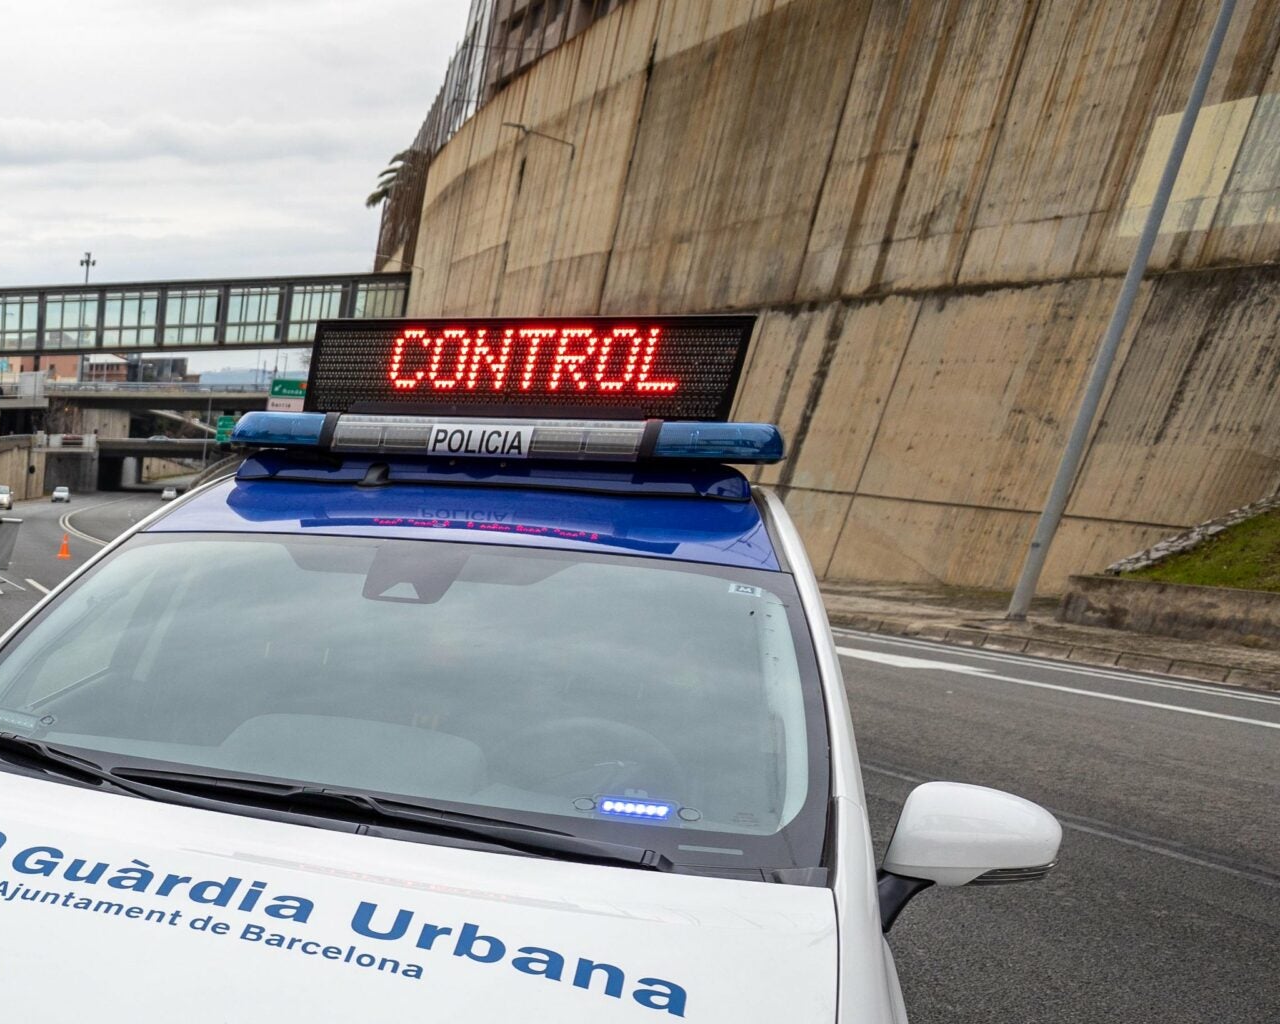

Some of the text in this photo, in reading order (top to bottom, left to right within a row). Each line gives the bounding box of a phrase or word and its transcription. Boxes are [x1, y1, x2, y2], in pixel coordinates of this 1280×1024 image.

[389, 329, 679, 391] CONTROL
[432, 428, 523, 455] POLICIA
[12, 847, 688, 1018] Guàrdia Urbana
[190, 916, 231, 936] de
[240, 924, 425, 980] Barcelona
